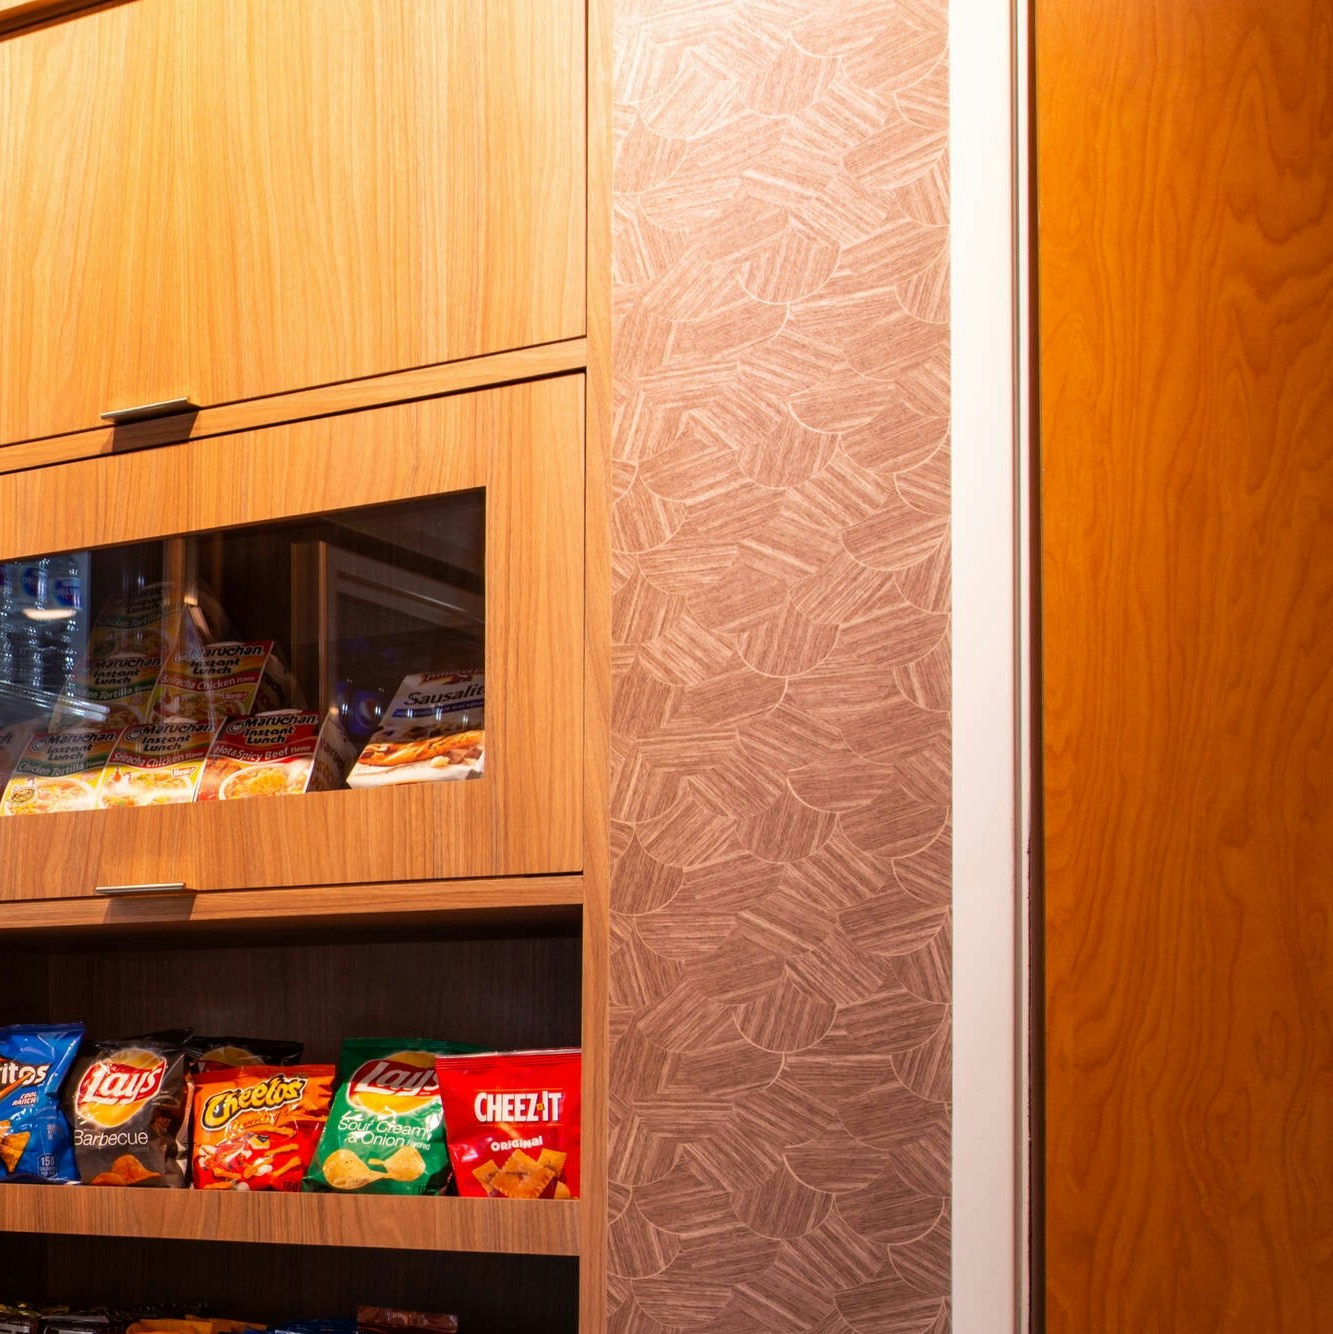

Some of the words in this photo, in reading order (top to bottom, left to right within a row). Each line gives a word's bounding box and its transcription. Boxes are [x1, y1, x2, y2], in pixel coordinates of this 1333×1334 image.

[162, 675, 201, 690] Sriracha
[201, 677, 236, 690] Chicken
[245, 714, 316, 730] Maruchan
[245, 726, 294, 736] Instant
[246, 734, 285, 744] Lunch
[113, 753, 147, 768] Sriracha
[147, 755, 184, 768] Chicken
[185, 752, 203, 760] Flavor
[236, 747, 263, 764] Spicy
[264, 747, 289, 761] Beef
[290, 745, 311, 753] Flavor
[82, 1063, 163, 1104] Lay's
[202, 1075, 305, 1130] Cheetos
[338, 1118, 374, 1132] Sour
[377, 1119, 426, 1136] Cream
[74, 1129, 148, 1146] Barbecue
[358, 1131, 405, 1147] Onion
